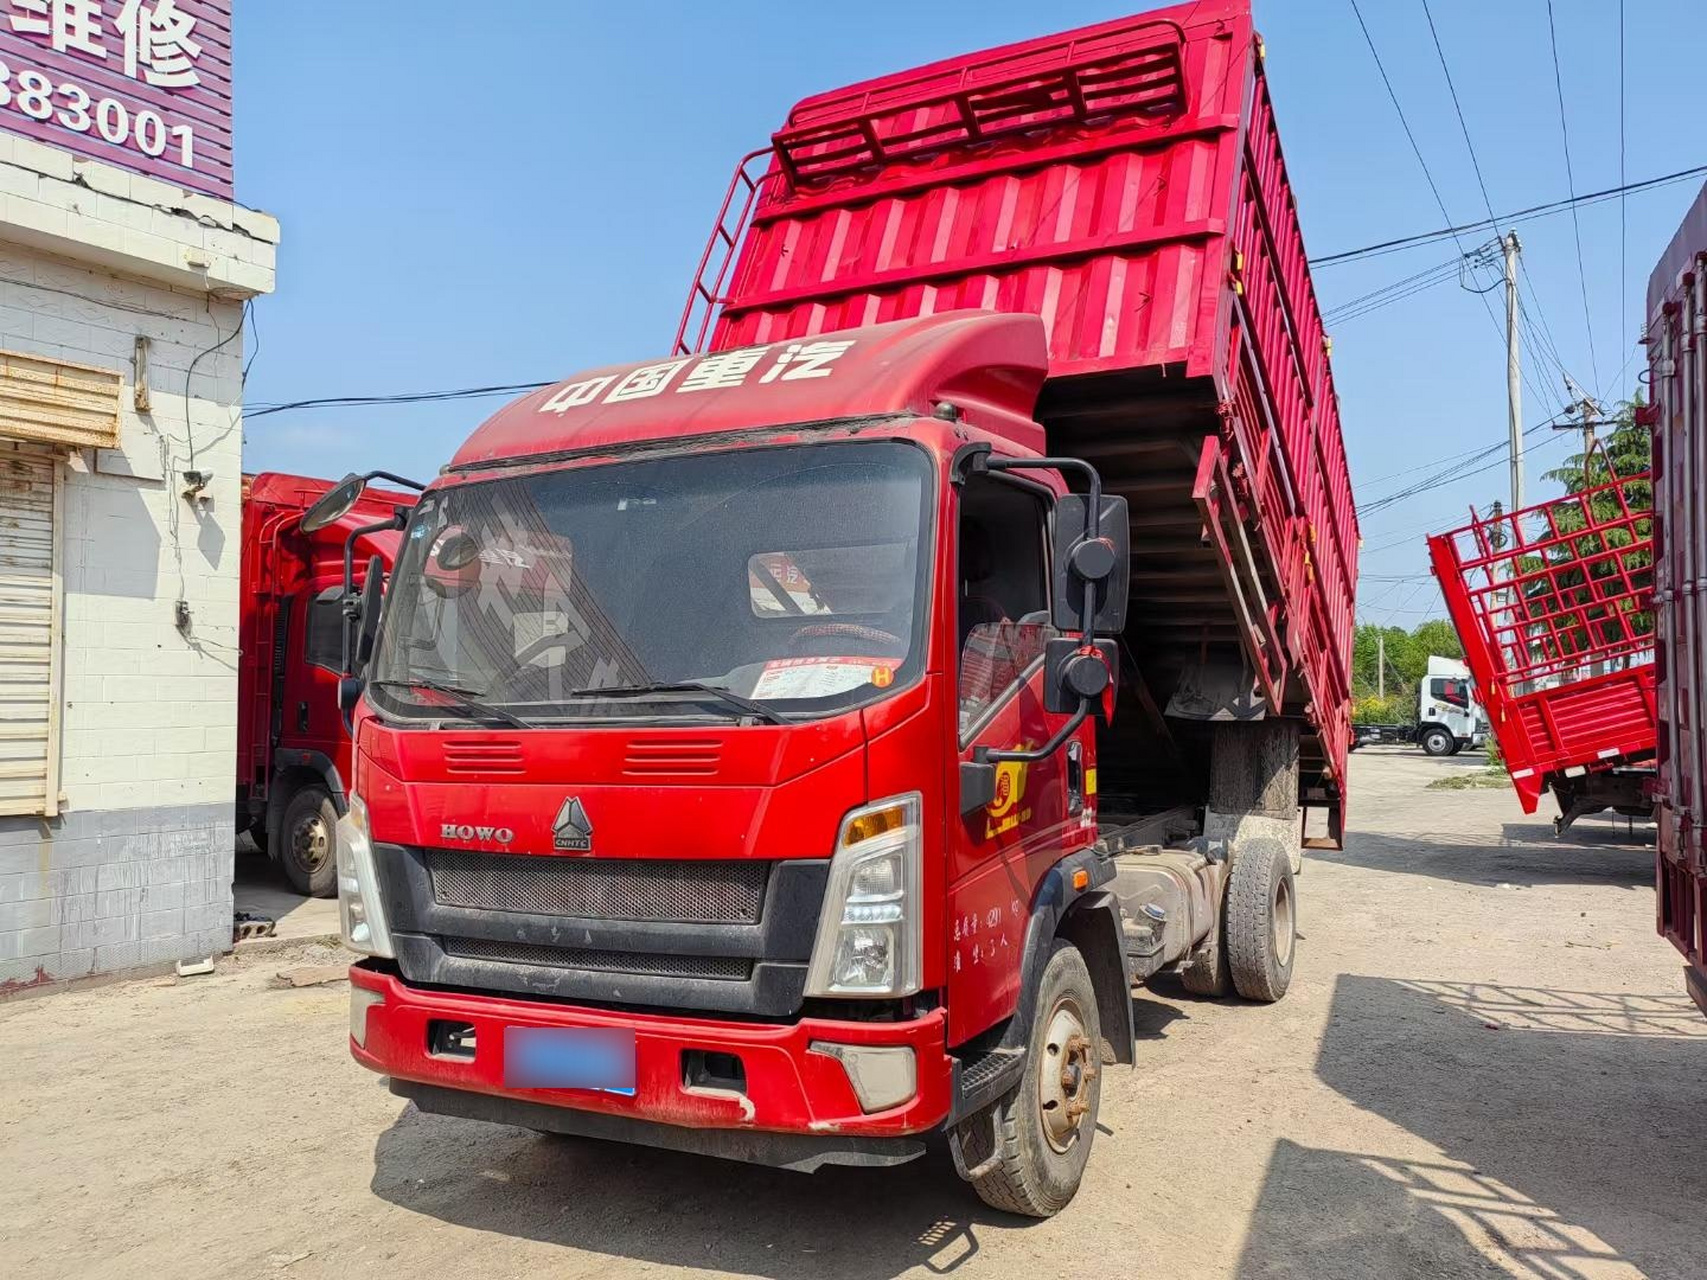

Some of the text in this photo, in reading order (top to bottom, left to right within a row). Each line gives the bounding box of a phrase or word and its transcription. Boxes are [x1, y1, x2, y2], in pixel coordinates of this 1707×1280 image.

[538, 339, 858, 418] 中国重汽
[440, 823, 514, 844] HOWO
[556, 839, 588, 848] CNHTC
